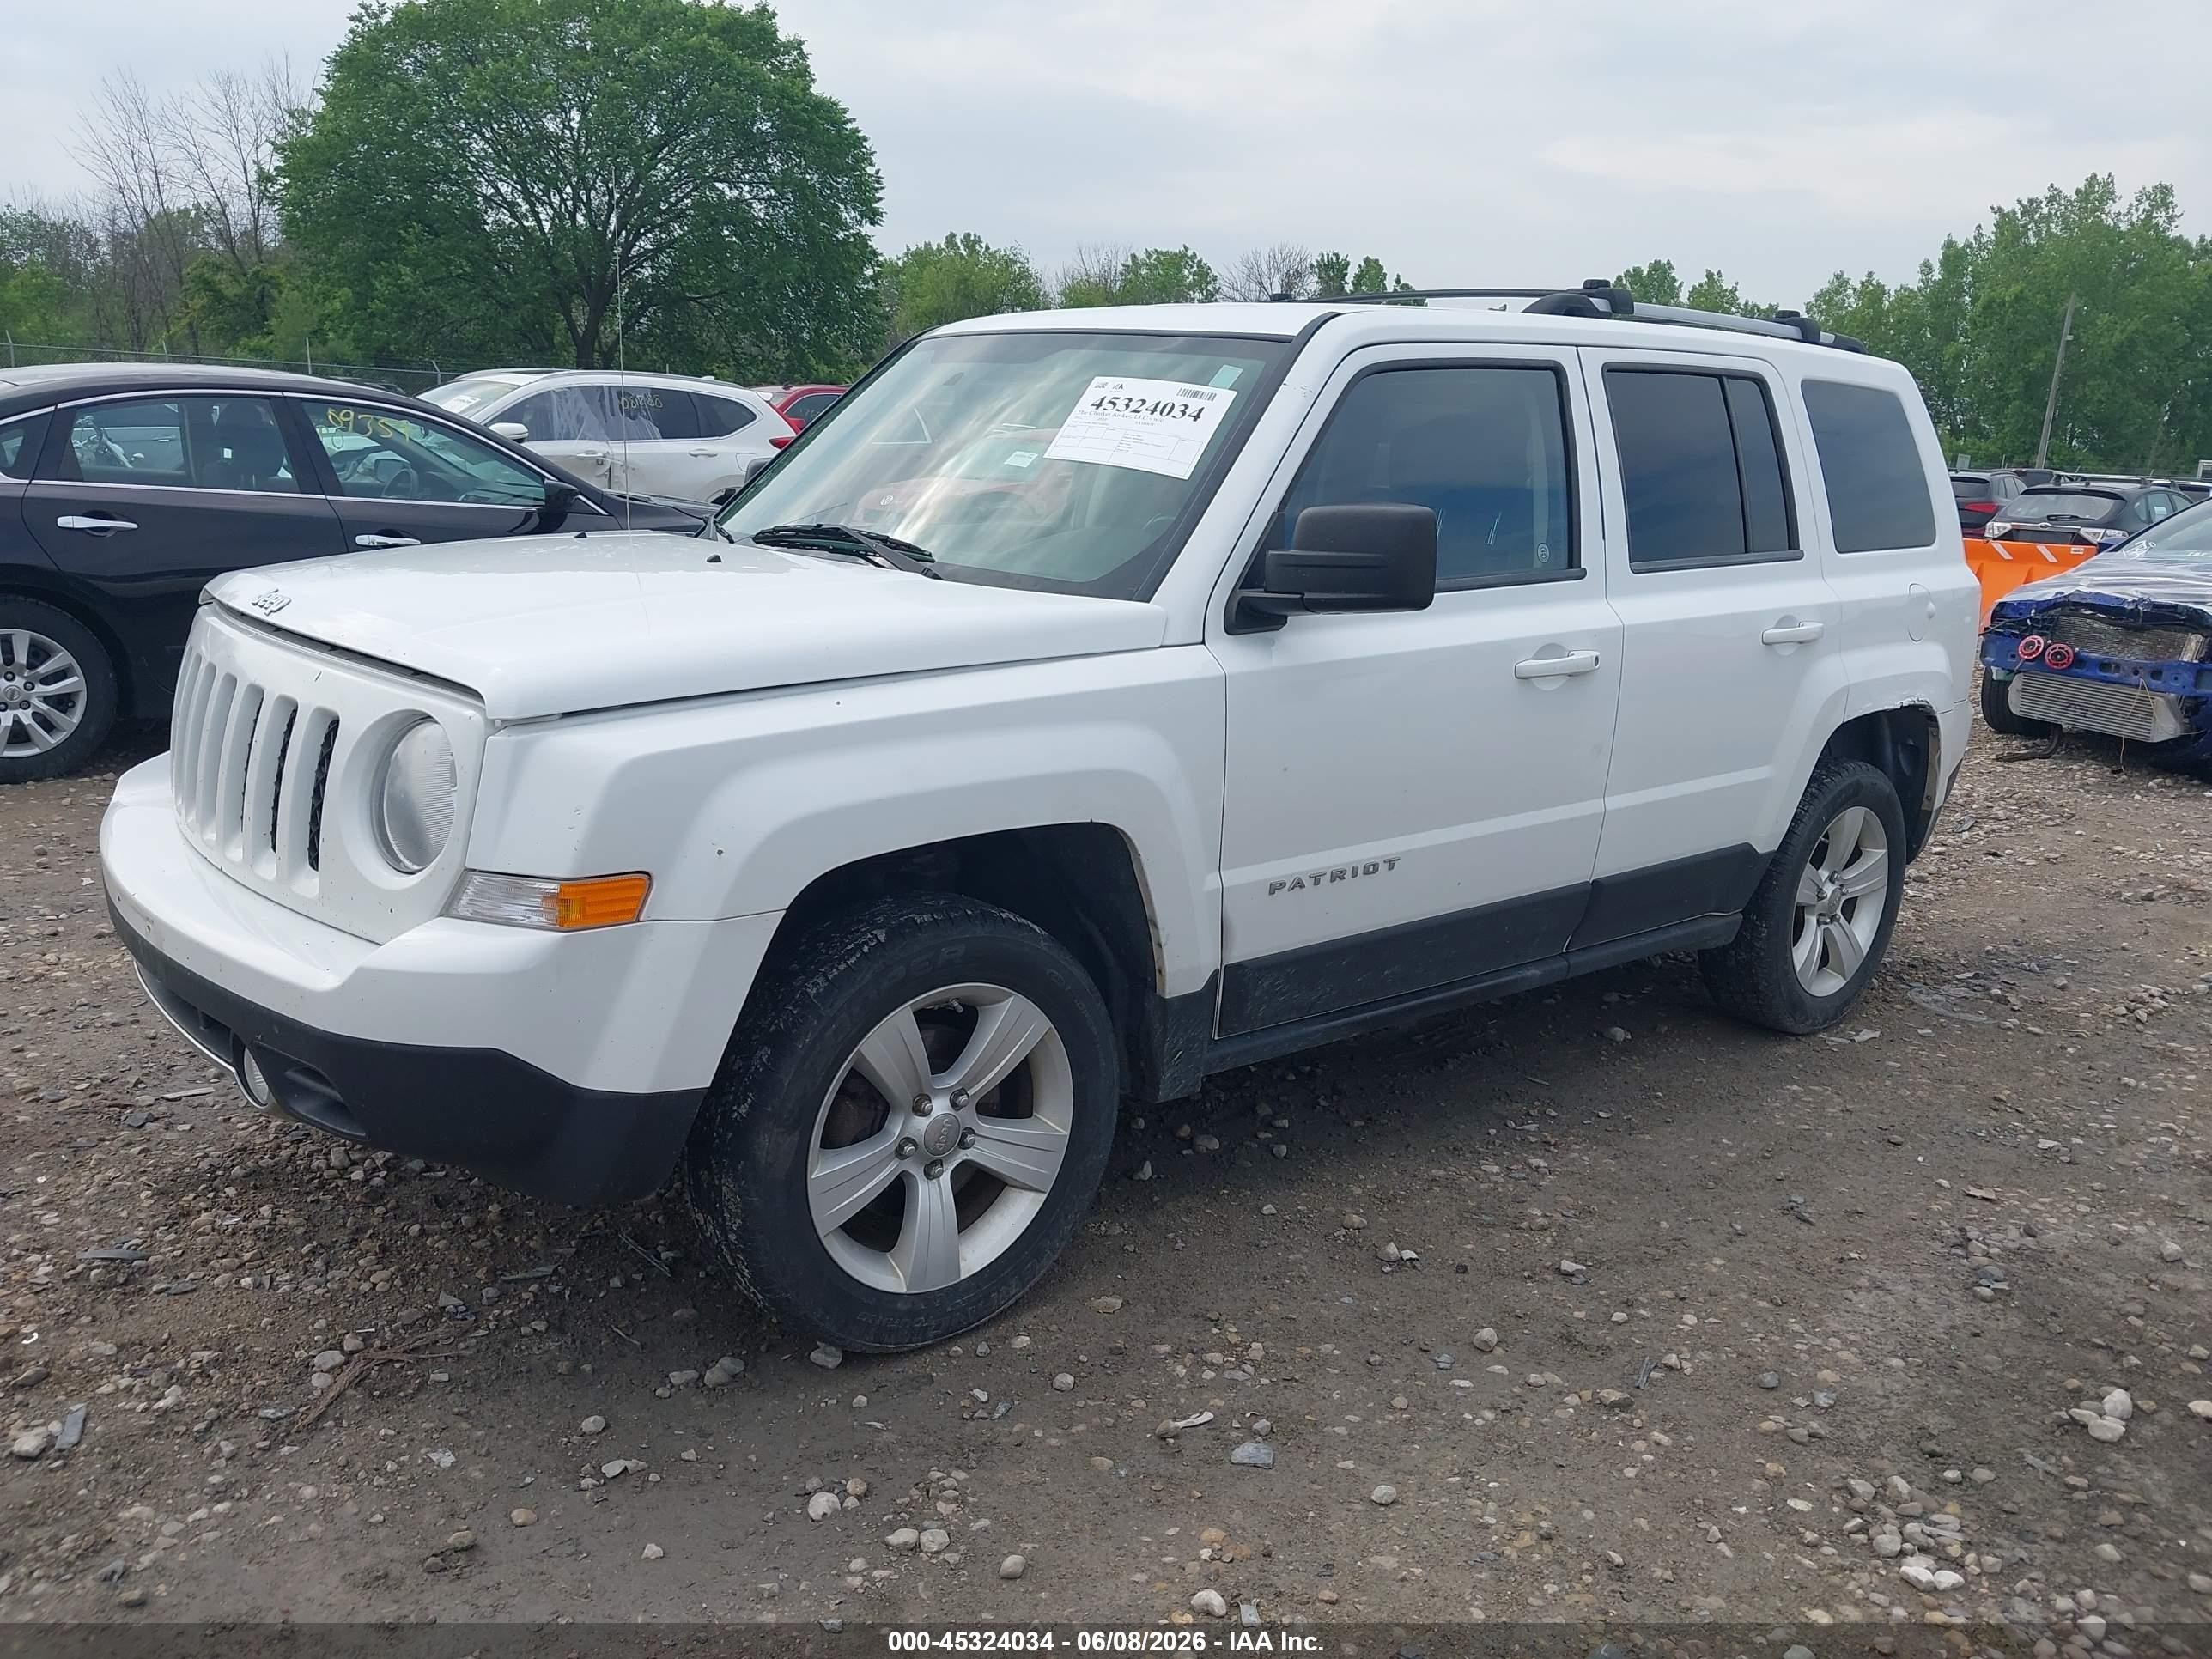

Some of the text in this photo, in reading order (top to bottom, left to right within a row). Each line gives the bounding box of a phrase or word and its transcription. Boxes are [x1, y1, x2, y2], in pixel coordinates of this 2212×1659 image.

[1091, 395, 1205, 422] 45324034
[252, 588, 291, 617] Jeep
[1268, 856, 1401, 896] PATRIOT
